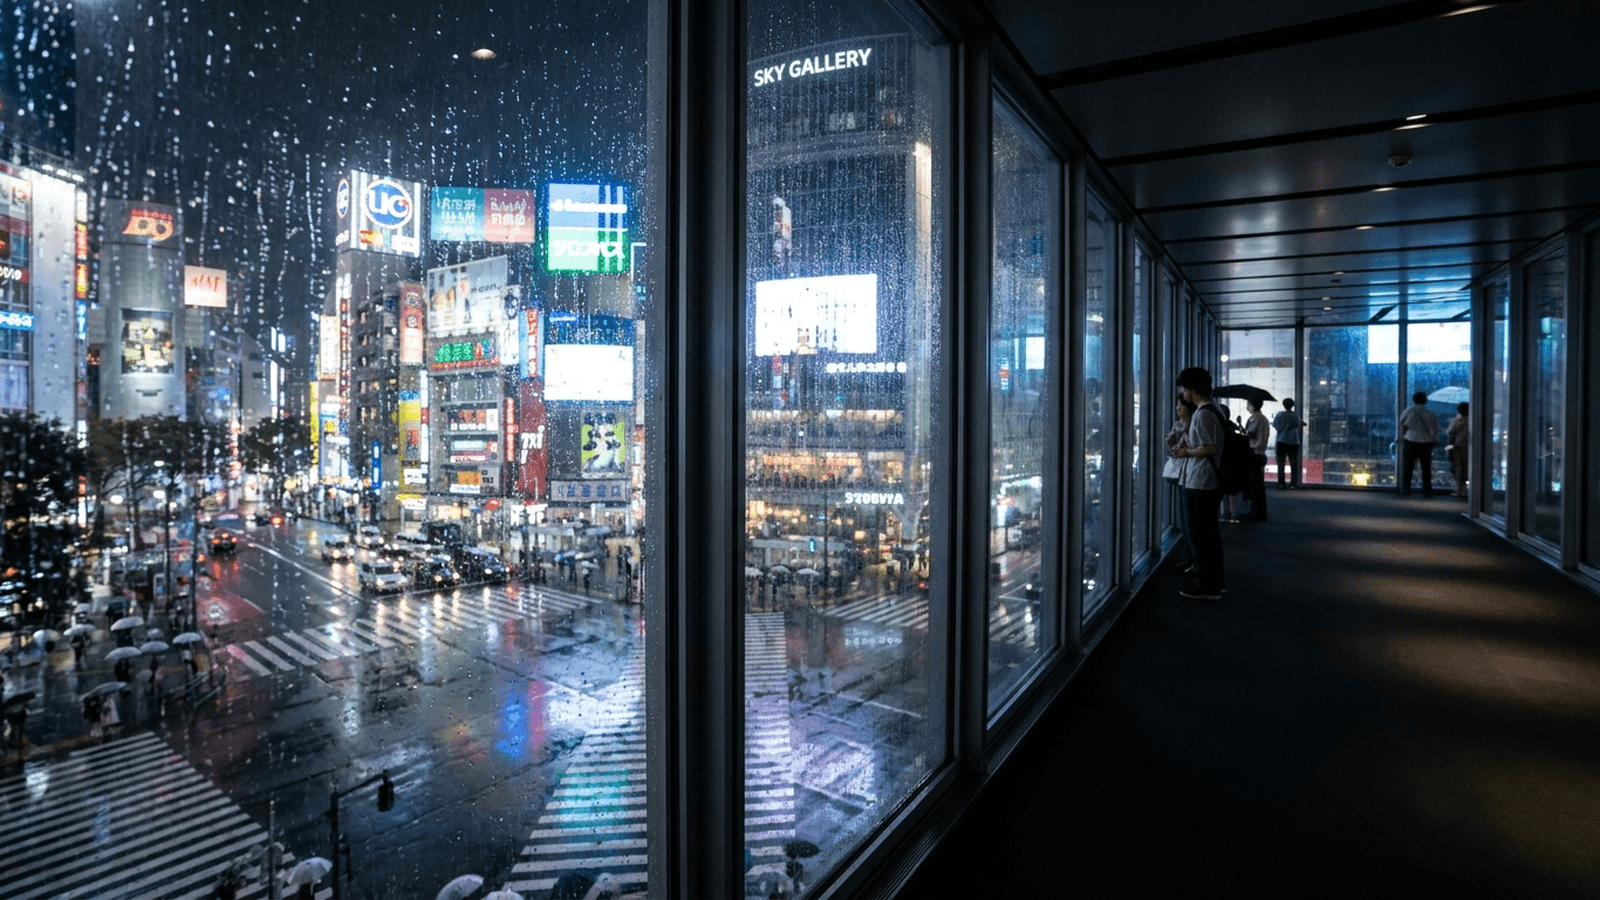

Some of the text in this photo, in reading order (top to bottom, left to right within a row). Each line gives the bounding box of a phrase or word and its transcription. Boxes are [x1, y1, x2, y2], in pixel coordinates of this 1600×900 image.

[754, 48, 872, 87] SKY GALLERY
[368, 189, 409, 218] UC
